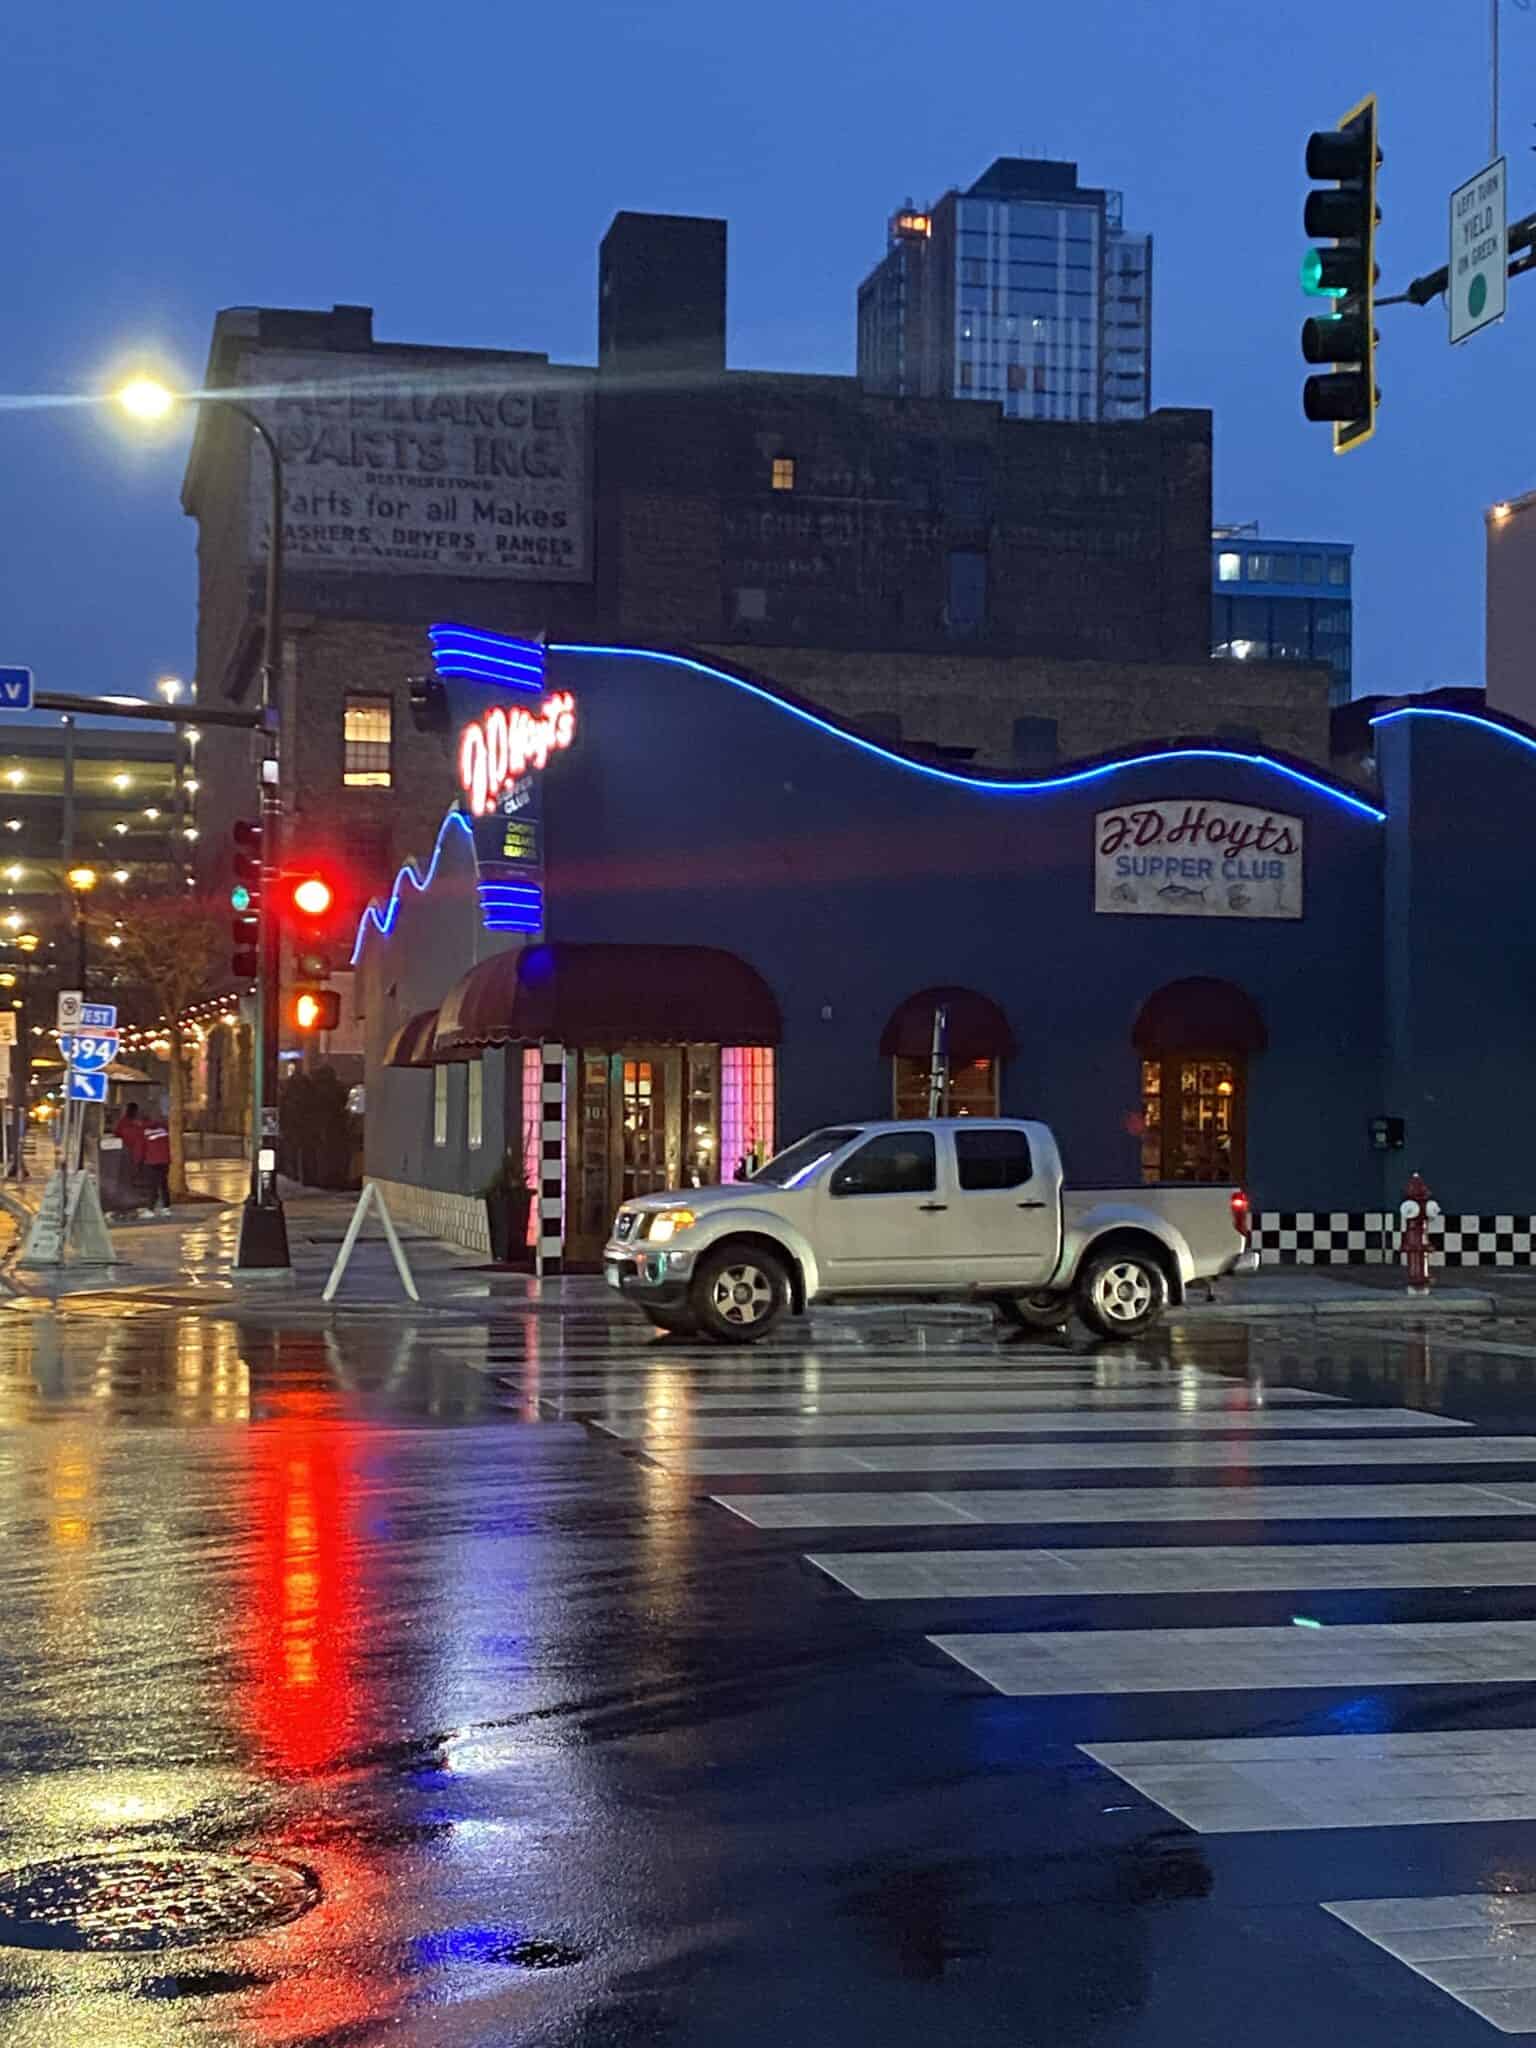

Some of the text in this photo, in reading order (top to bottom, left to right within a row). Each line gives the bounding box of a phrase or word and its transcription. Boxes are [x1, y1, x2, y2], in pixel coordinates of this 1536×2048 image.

[1457, 174, 1498, 217] LEFT TURN
[1463, 205, 1494, 247] YIELD
[1471, 235, 1499, 266] GREEN
[367, 492, 411, 519] for
[427, 496, 458, 523] all
[472, 498, 569, 529] Makes
[392, 529, 476, 550] DRYERS
[495, 533, 574, 555] RANGES
[0, 682, 22, 700] V
[1100, 806, 1299, 859] J.D. Hoyts
[1115, 854, 1285, 880] SUPPER CLUB
